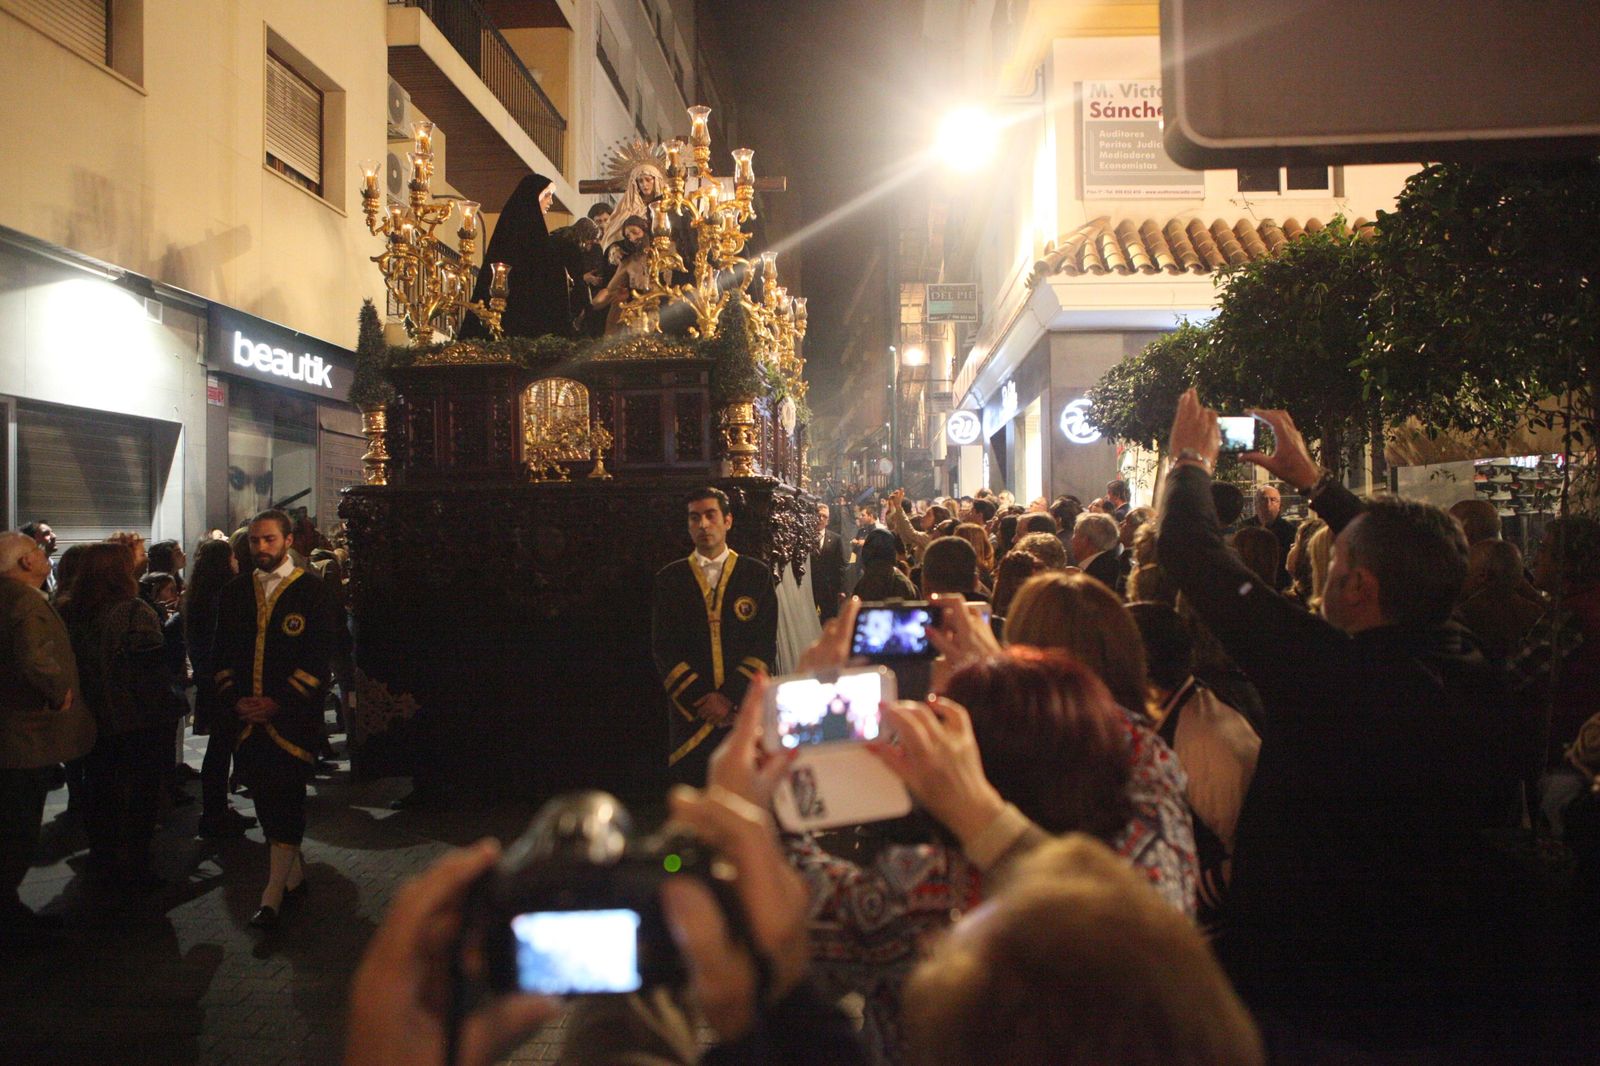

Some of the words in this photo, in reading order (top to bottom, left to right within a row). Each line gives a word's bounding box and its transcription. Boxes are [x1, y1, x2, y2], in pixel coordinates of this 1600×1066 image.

[1089, 83, 1114, 98] M.
[1099, 129, 1145, 138] Auditores
[1099, 140, 1132, 149] Peritos
[1099, 150, 1156, 160] Mediadores
[1099, 160, 1158, 170] Economistas
[233, 330, 333, 389] beautik
